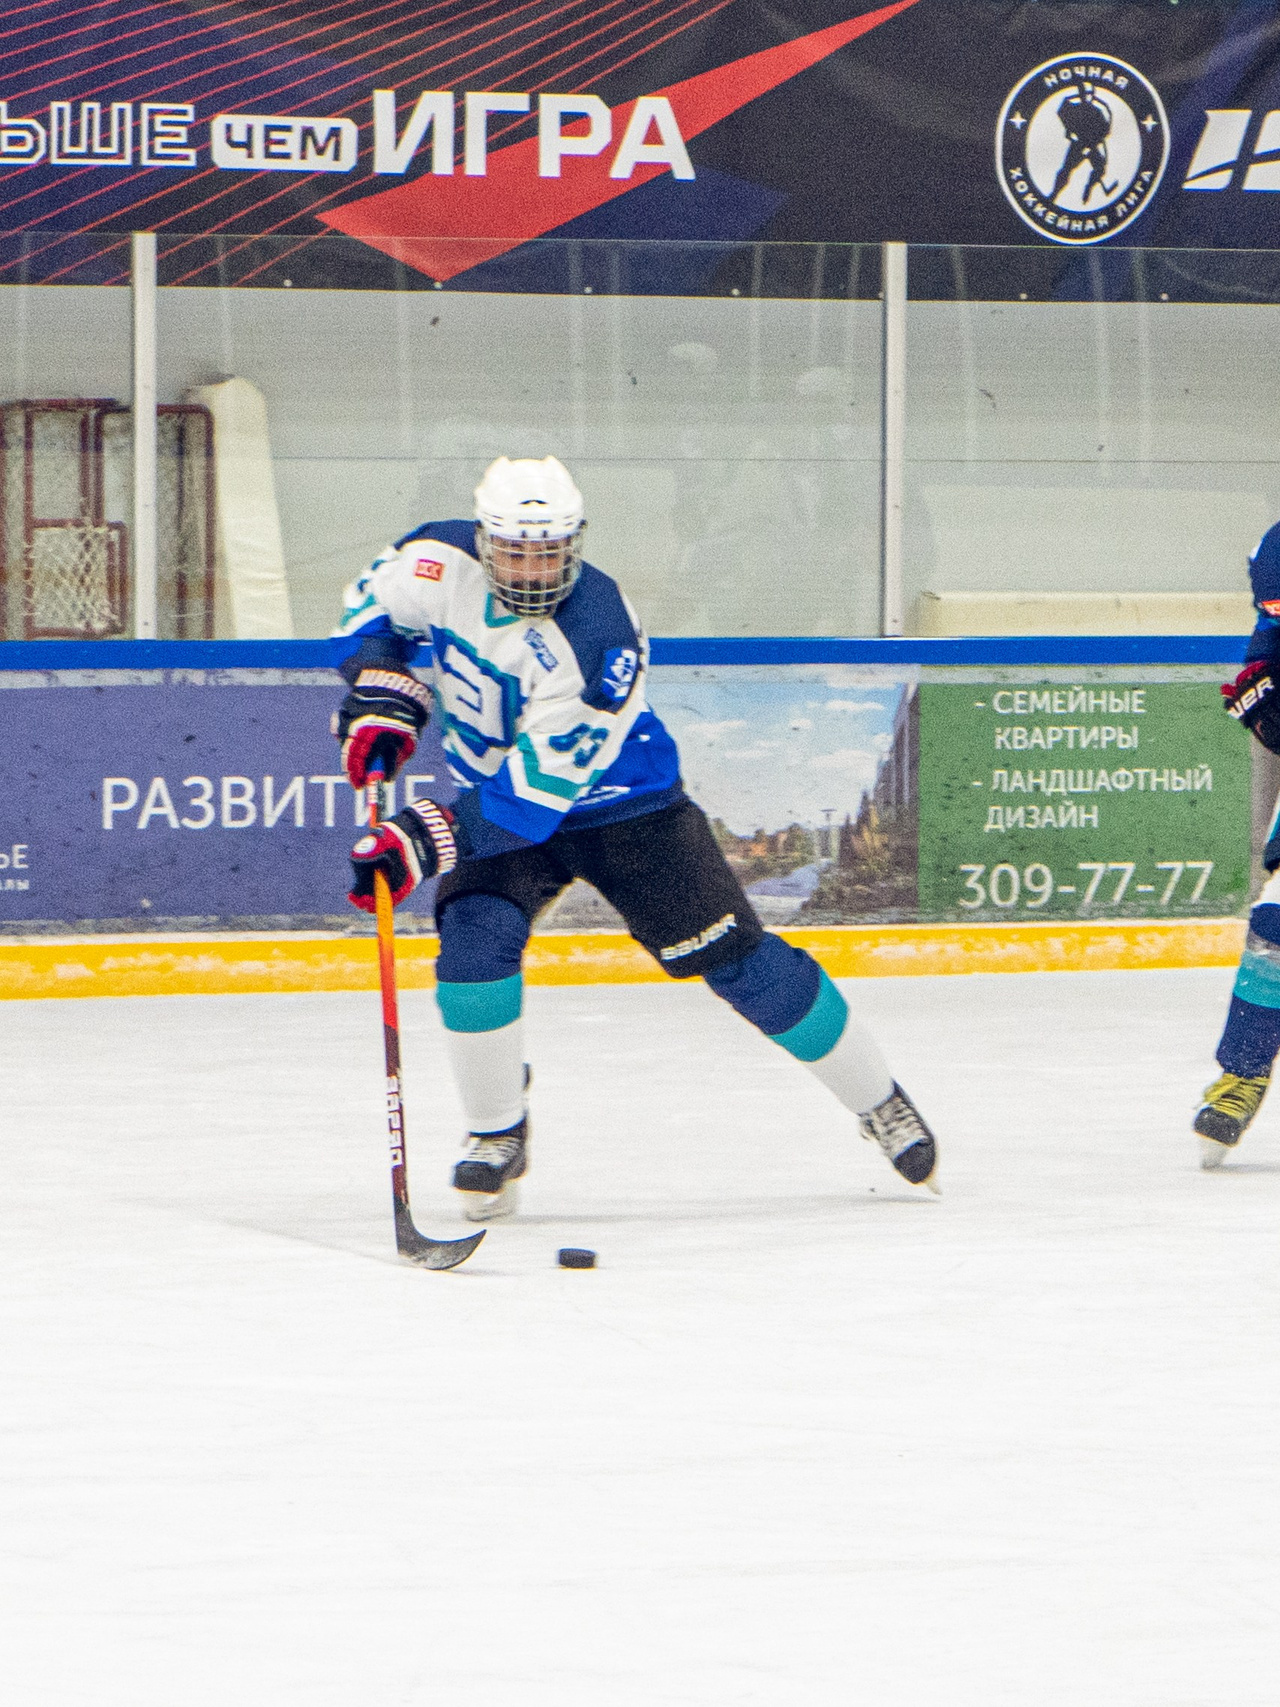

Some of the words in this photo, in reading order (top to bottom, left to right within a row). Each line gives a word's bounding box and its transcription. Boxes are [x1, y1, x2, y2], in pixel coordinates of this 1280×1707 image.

[1042, 64, 1129, 91] НОЧНАЯ
[222, 122, 344, 163] ЧЕМ
[372, 88, 697, 181] ИГРА
[1008, 166, 1110, 233] ХОККЕЙНАЯ
[1114, 169, 1154, 218] ЛИГА
[992, 686, 1147, 716] СЕМЕЙНЫЕ
[994, 725, 1139, 751] КВАРТИРЫ
[990, 763, 1213, 797] ЛАНДШАФТНЫЙ
[983, 800, 1100, 834] ДИЗАЙН
[957, 860, 1215, 910] 309-77-77
